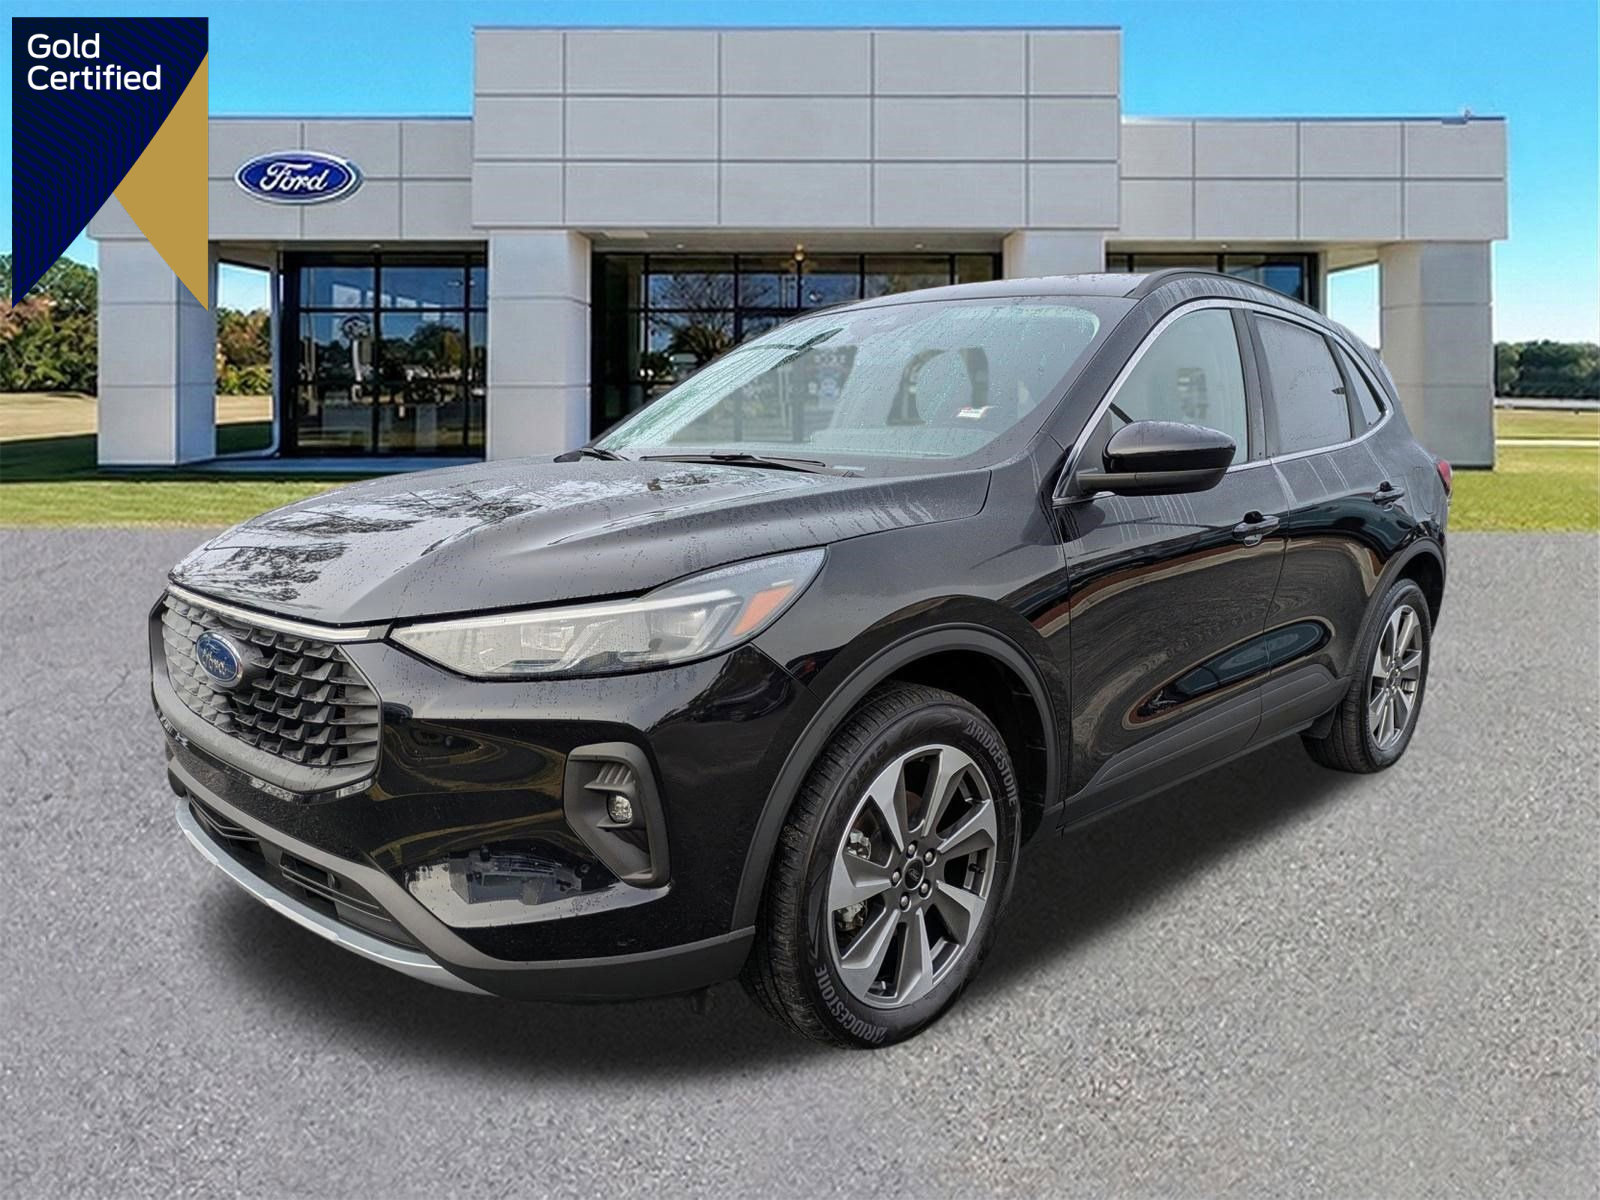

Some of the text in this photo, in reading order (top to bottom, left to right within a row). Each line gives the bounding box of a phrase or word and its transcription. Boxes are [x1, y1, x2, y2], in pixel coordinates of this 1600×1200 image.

[259, 161, 331, 192] Ford
[963, 718, 1018, 807] BRIDGESTONE
[814, 962, 889, 1044] BRIDGESTONE
